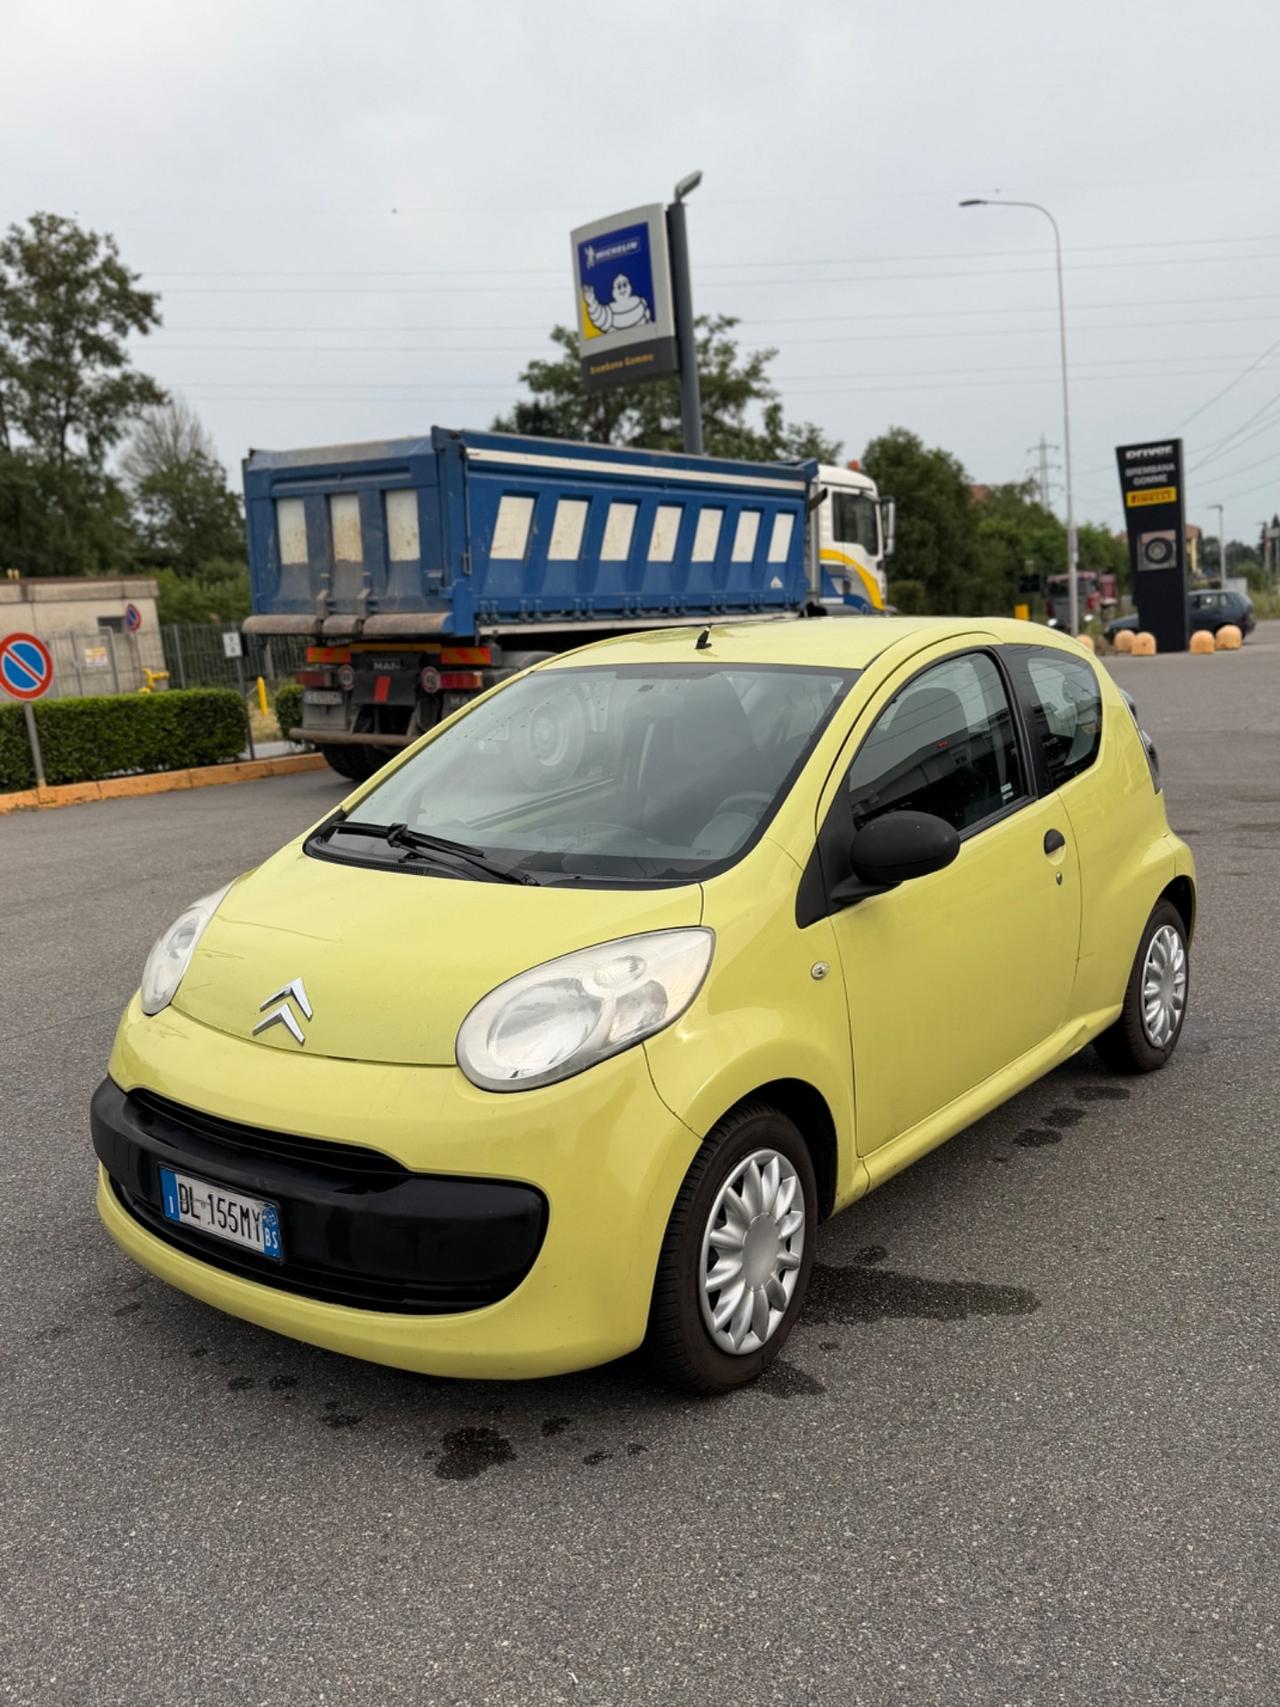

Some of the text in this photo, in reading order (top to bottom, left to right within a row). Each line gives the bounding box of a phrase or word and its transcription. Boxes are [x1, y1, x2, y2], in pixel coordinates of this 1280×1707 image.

[596, 241, 638, 260] MICHELIN
[1125, 462, 1176, 477] BREMBANA
[1133, 473, 1168, 486] GOMME
[1131, 490, 1172, 504] PIRELLI
[373, 661, 400, 670] MAN
[264, 1227, 278, 1249] BS
